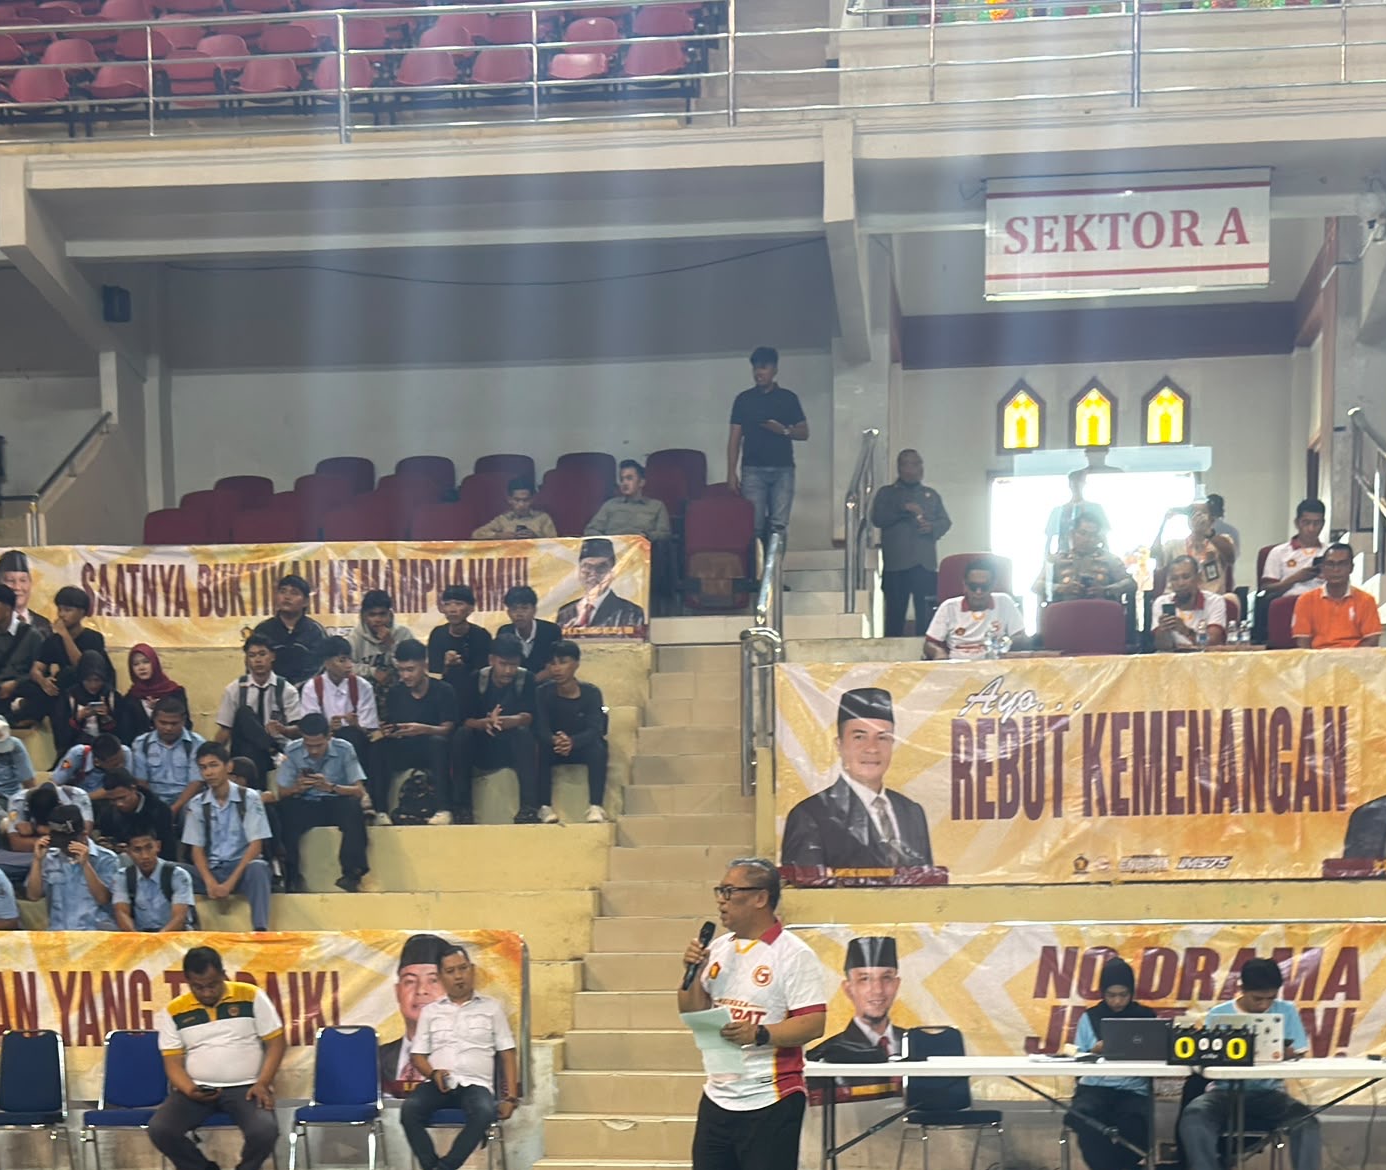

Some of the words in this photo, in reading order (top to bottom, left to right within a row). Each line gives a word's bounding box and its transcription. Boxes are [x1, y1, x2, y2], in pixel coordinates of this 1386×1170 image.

[1003, 209, 1204, 255] SEKTOR
[1214, 206, 1251, 246] A
[80, 562, 191, 618] SAATNYA
[950, 713, 1071, 822] REBUT
[1082, 705, 1349, 817] KEMENANGAN
[1174, 1036, 1195, 1059] 0
[1226, 1037, 1247, 1060] 0
